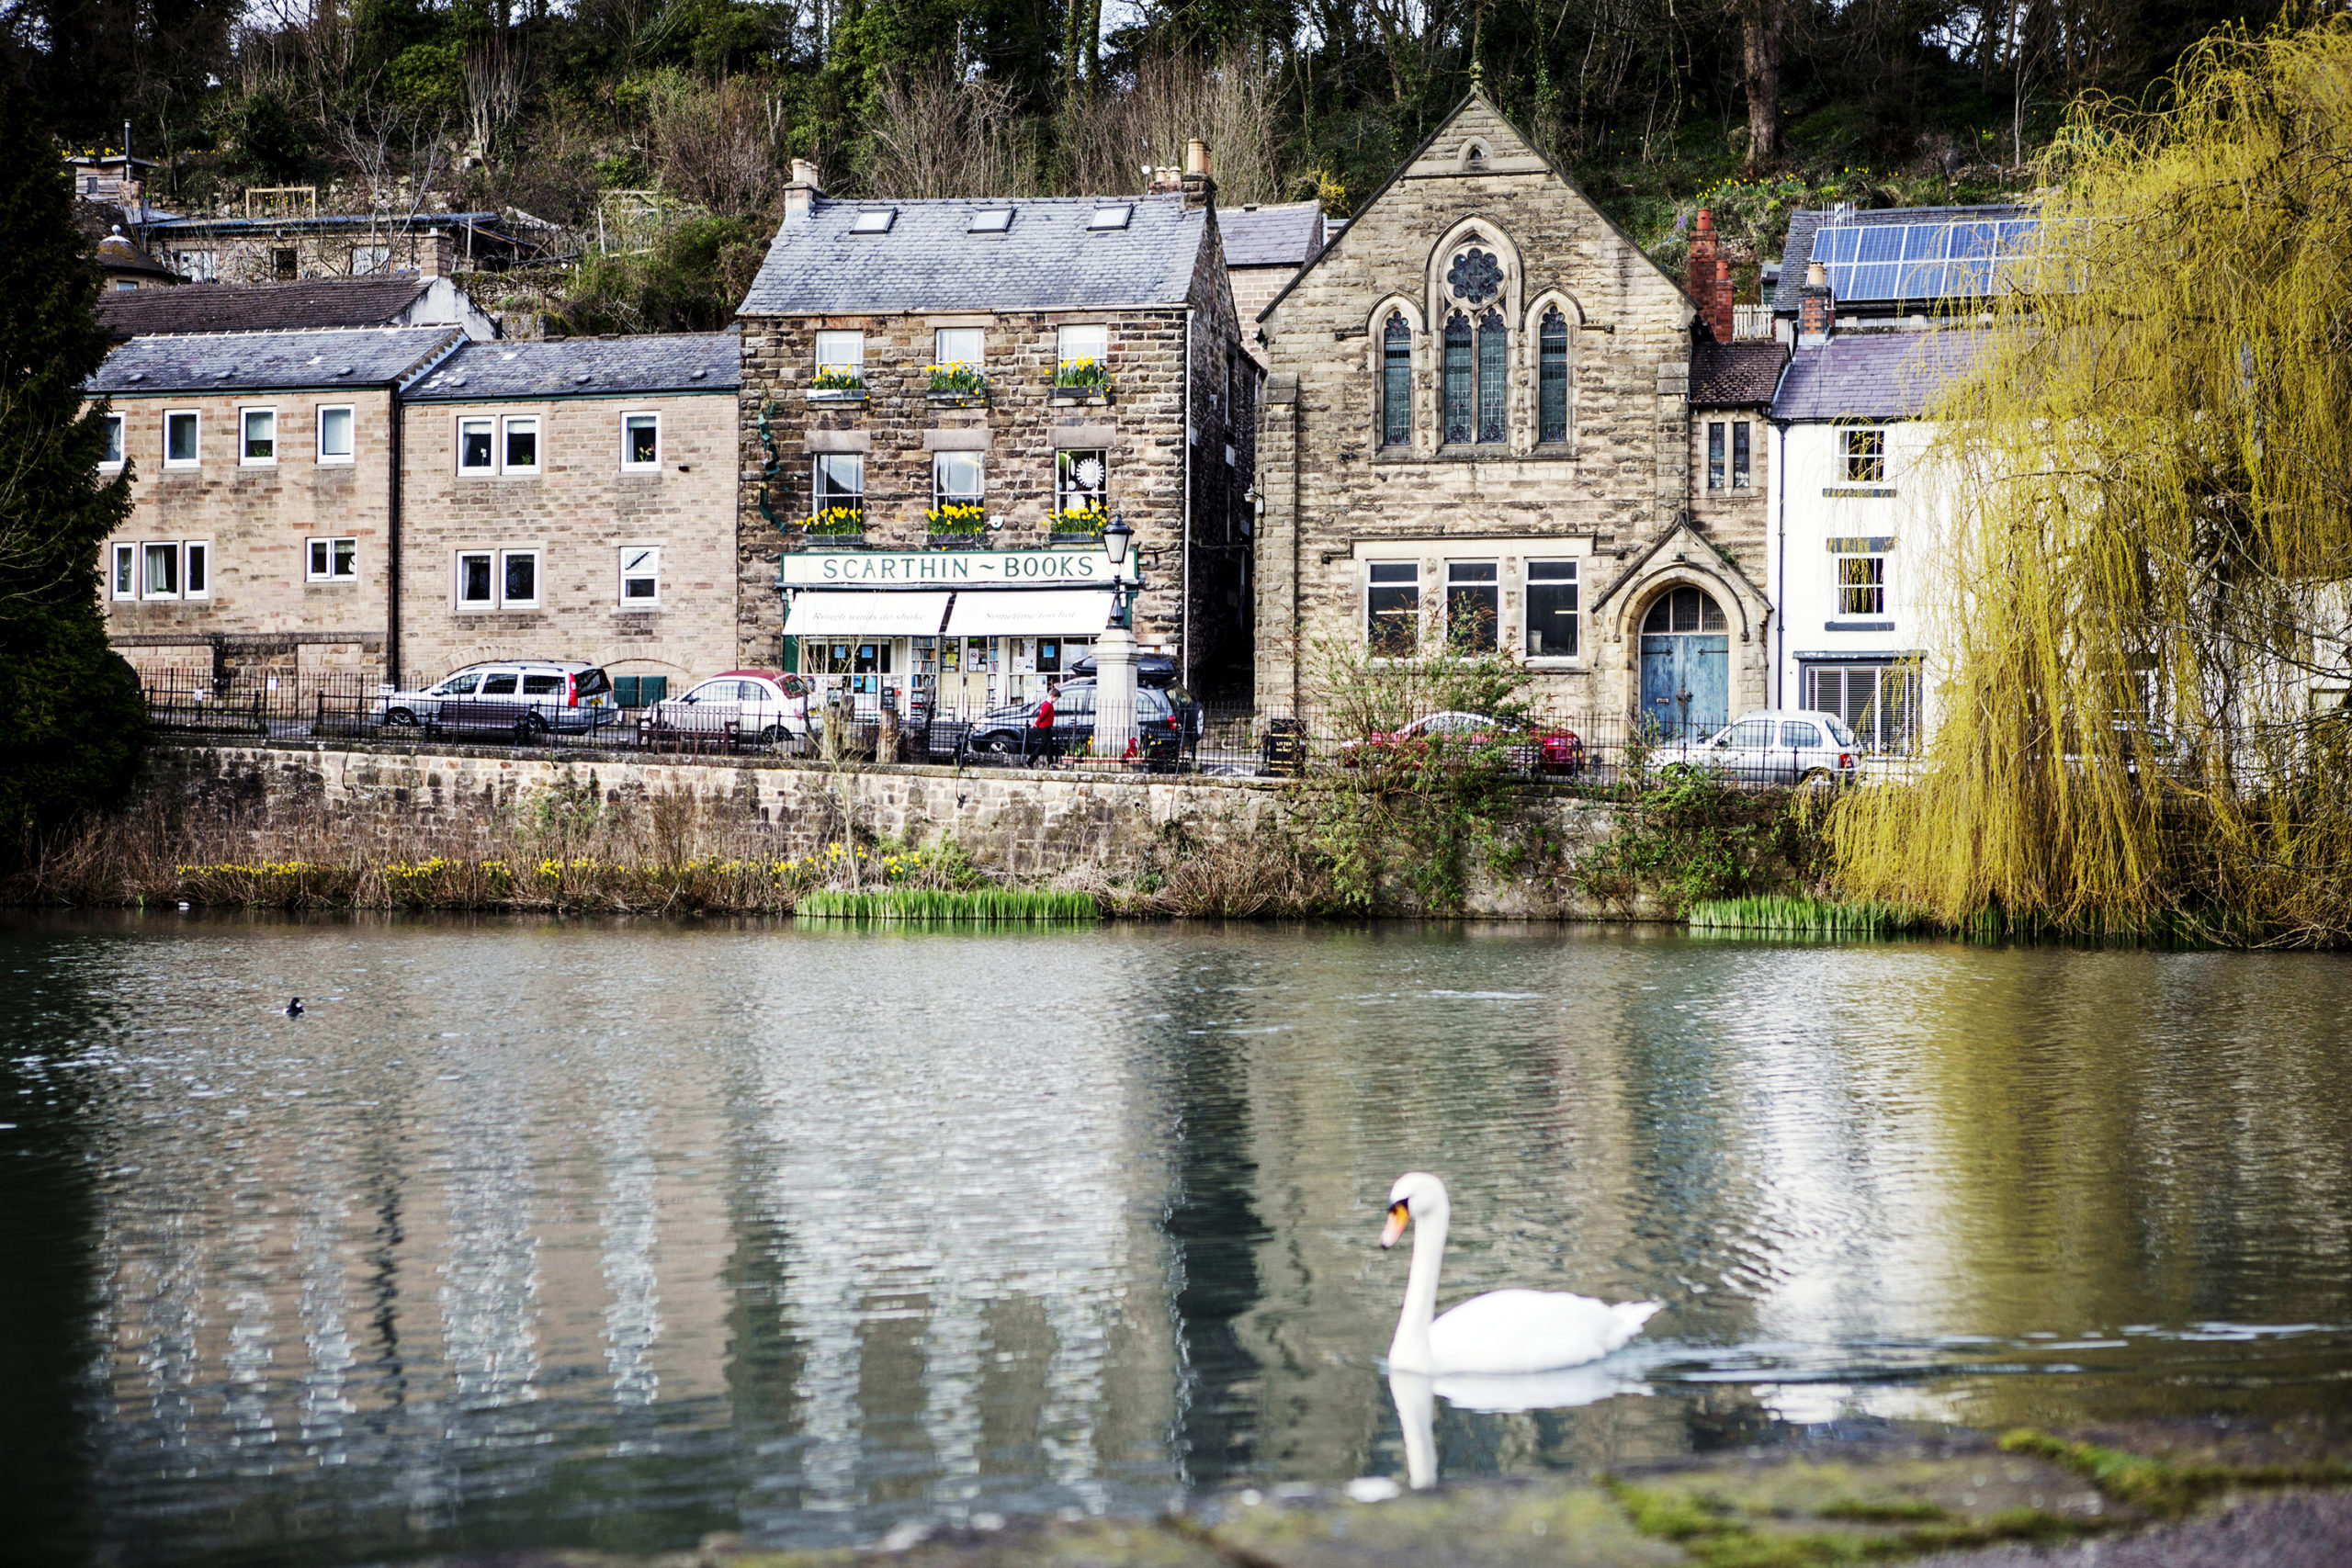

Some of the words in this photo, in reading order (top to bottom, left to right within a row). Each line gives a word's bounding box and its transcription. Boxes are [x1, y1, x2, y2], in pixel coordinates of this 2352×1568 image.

[823, 558, 968, 578] SCARTHIN
[1004, 557, 1093, 577] BOOKS
[812, 612, 845, 621] Rough
[849, 612, 876, 621] winds
[879, 613, 893, 621] do
[896, 613, 926, 621] shake
[986, 612, 1036, 620] Sometime
[1038, 611, 1056, 619] too
